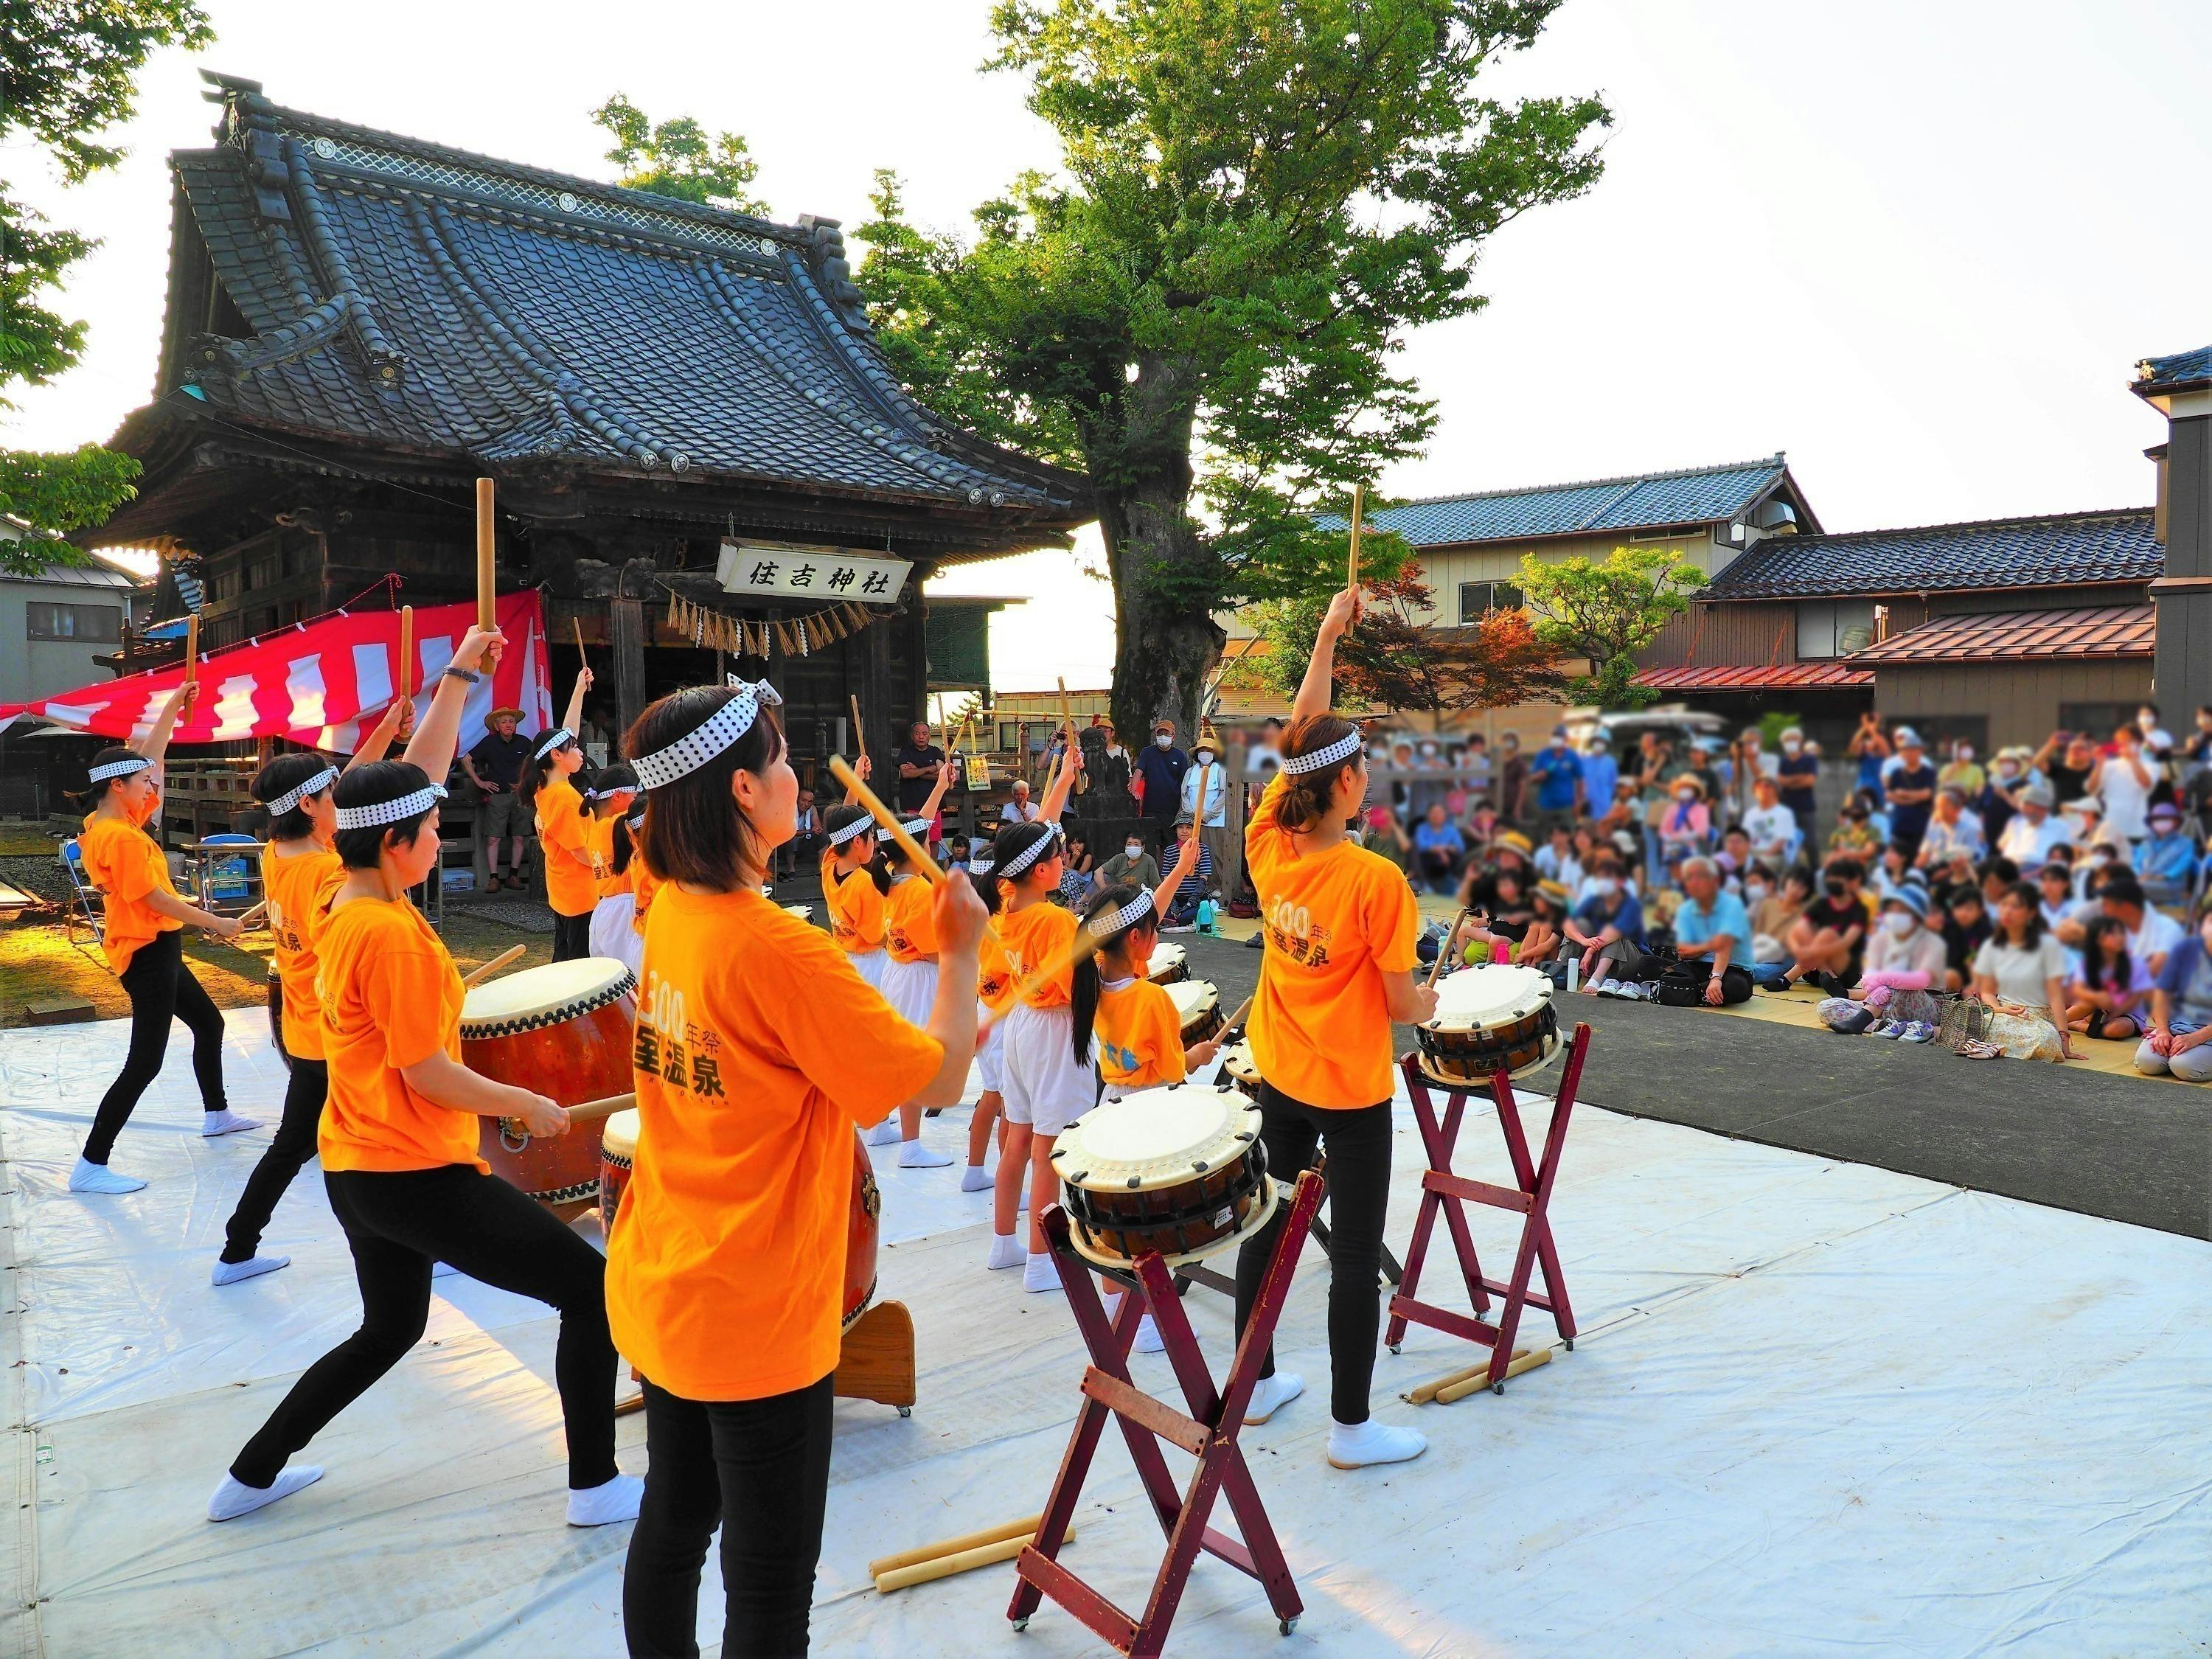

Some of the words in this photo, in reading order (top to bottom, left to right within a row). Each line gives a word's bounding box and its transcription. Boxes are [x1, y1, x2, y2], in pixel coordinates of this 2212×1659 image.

[749, 560, 889, 594] 住吉神社
[1265, 918, 1330, 967] 室温泉
[633, 1025, 726, 1099] 室温泉
